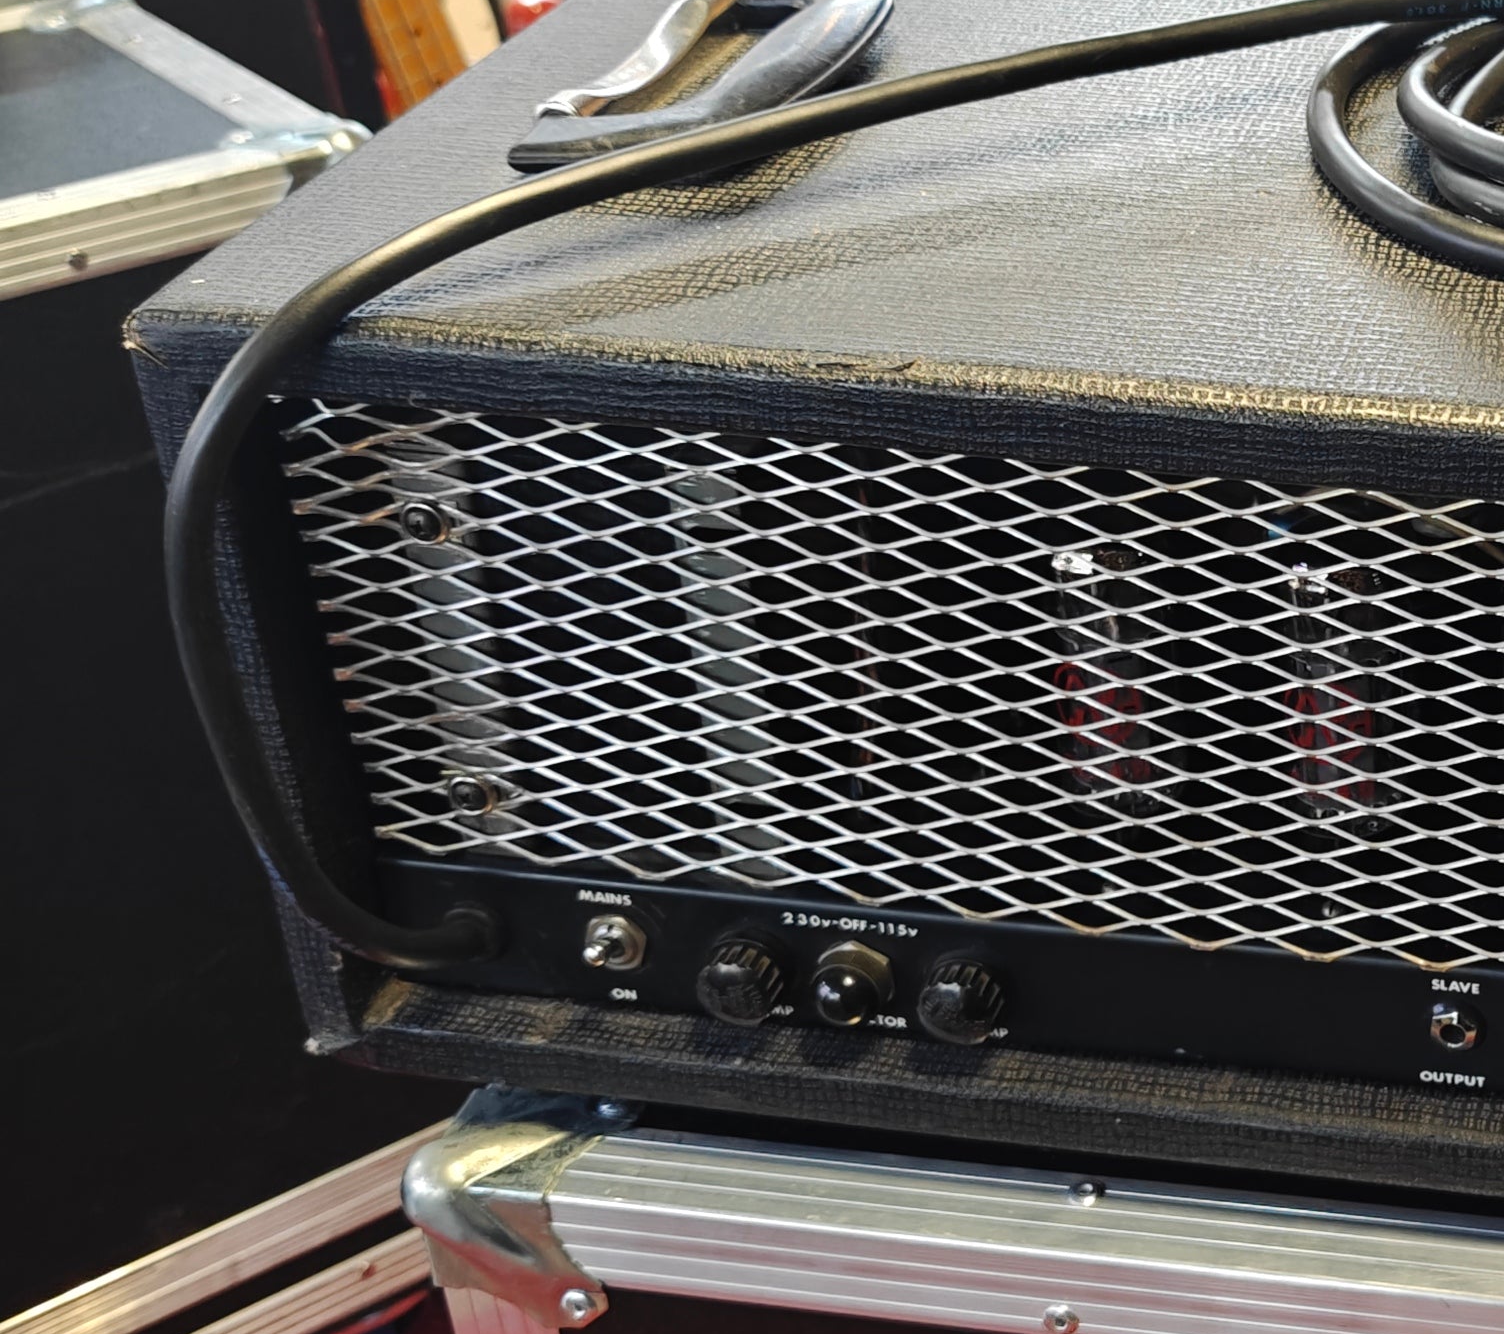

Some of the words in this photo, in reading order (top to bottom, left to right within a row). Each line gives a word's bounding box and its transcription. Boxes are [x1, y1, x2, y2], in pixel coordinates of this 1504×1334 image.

[578, 889, 632, 906] MAINS
[611, 987, 637, 1001] ON
[1431, 978, 1480, 995] SLAVE
[1419, 1070, 1486, 1088] OUTPUT
